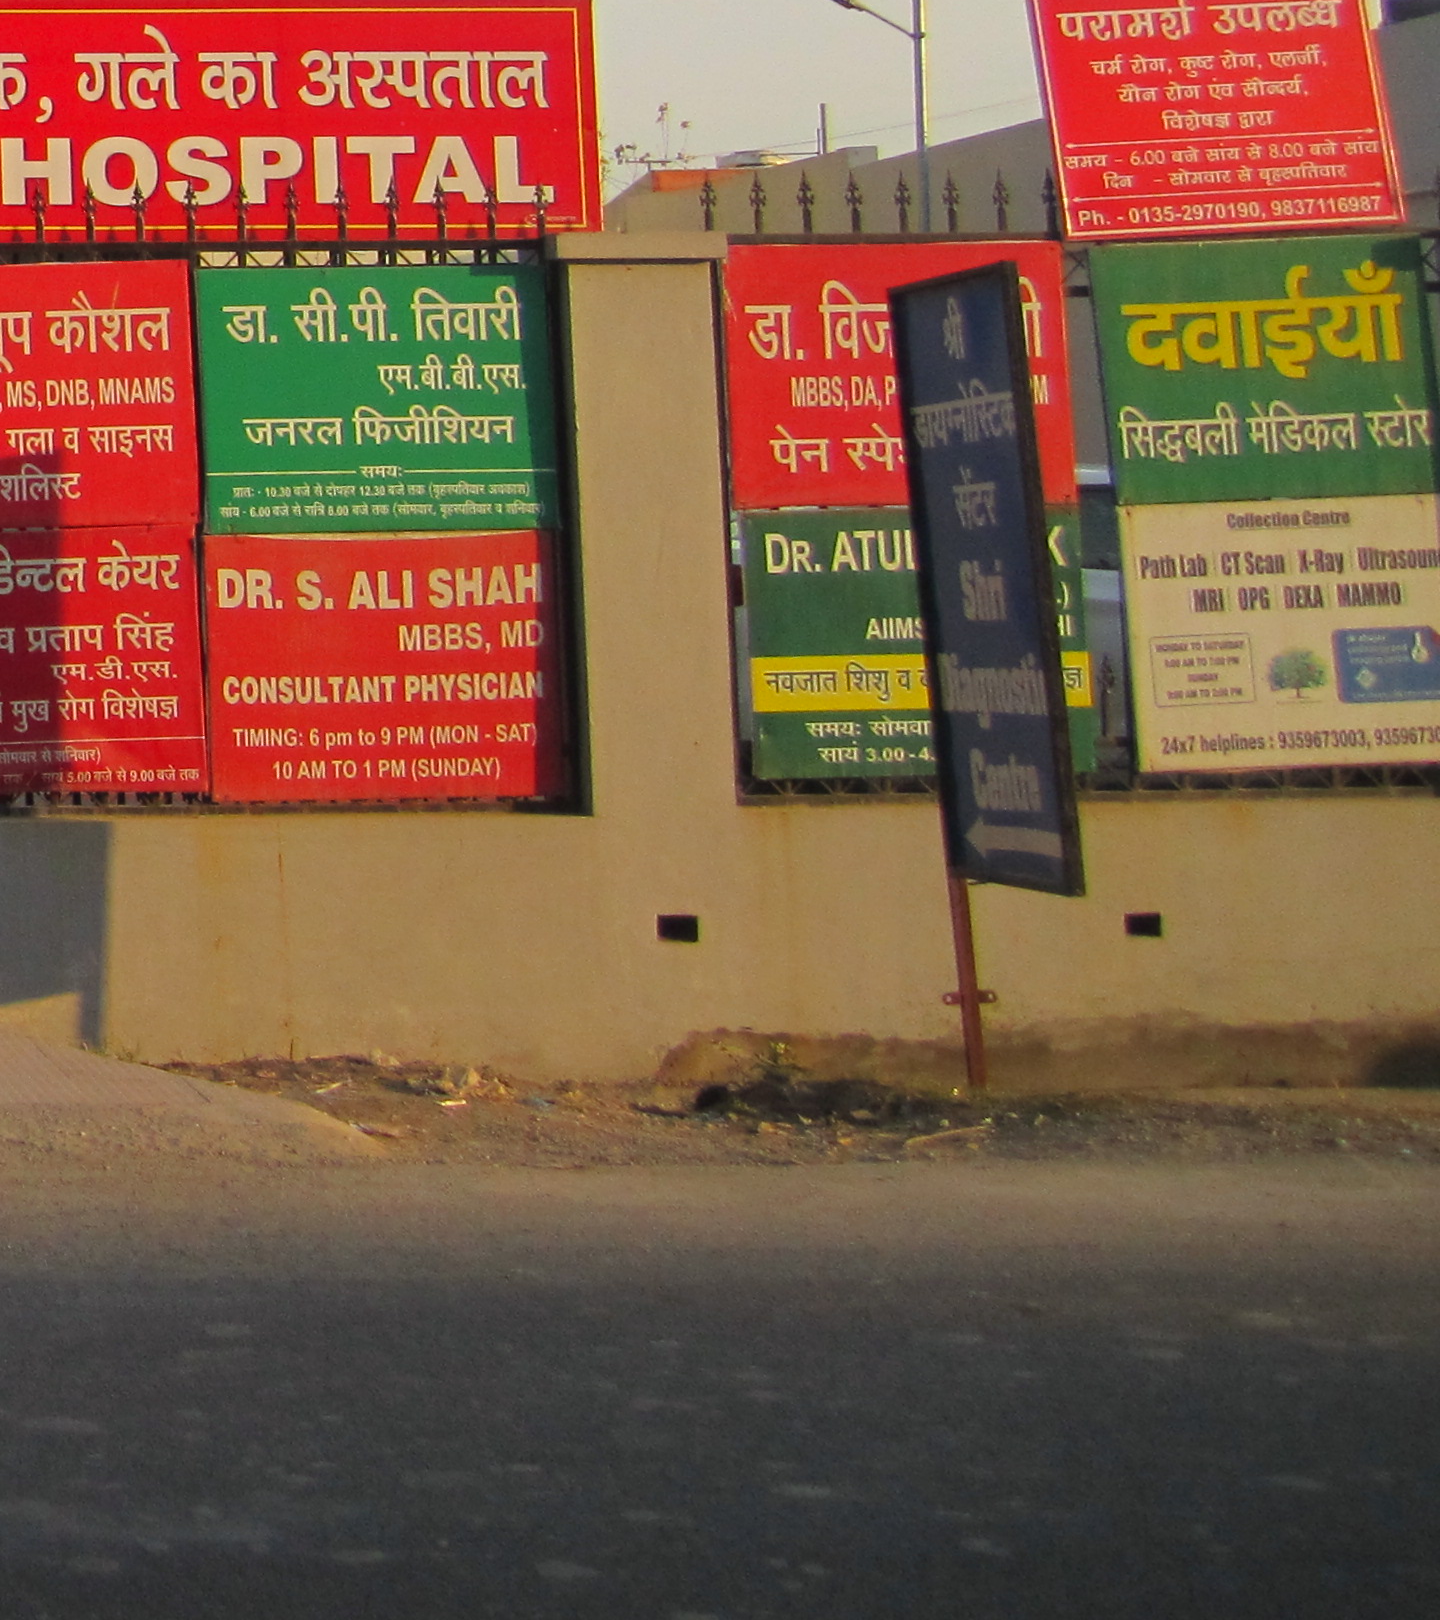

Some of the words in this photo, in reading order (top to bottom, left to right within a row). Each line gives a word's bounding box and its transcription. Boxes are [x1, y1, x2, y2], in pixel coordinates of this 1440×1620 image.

[1208, 0, 1342, 35] उपलब्ध
[75, 24, 181, 110] गले
[198, 50, 276, 110] का
[298, 50, 549, 110] अस्पताल
[1161, 110, 1229, 131] विशेषज्ञ
[1239, 110, 1274, 130] द्वारा
[0, 136, 554, 206] HOSPITAL
[1064, 153, 1107, 169] समय
[1130, 150, 1165, 166] 6.00
[1171, 147, 1199, 163] बजे
[1246, 141, 1263, 160] से
[1269, 143, 1304, 158] 8.00
[1308, 141, 1336, 157] बजे
[1103, 172, 1132, 189] दिन
[1169, 168, 1231, 186] सोमवार
[1237, 166, 1252, 184] से
[1078, 209, 1111, 226] Ph.
[1128, 202, 1266, 223] 0135-2970190,
[1272, 196, 1382, 216] 9837116987
[45, 290, 171, 354] कौशल
[223, 305, 278, 344] डा.
[291, 287, 398, 343] सी.पी.
[411, 285, 521, 341] तिवारी
[745, 304, 805, 360] डा.
[1121, 260, 1406, 379] दवाईयाँ
[378, 354, 527, 394] एम.बी.बी.एस.
[6, 379, 42, 412] MS,
[46, 379, 95, 411] DNB,
[99, 377, 175, 405] MNAMS
[791, 376, 848, 411] MBBS,
[851, 376, 882, 411] DA,
[5, 428, 54, 456] गला
[63, 427, 80, 454] व
[87, 425, 174, 459] साइनस
[243, 417, 343, 446] जनरल
[353, 404, 516, 445] फिजीशियन
[1119, 402, 1240, 463] सिद्धबली
[1245, 400, 1358, 454] मेडिकल
[1363, 394, 1433, 448] स्टोर
[770, 424, 830, 473] पेन
[1227, 511, 1299, 529] Collection
[1303, 510, 1351, 526] Centre
[97, 539, 181, 591] केयर
[1139, 555, 1175, 579] Path
[1180, 553, 1207, 577] Lab
[1221, 553, 1243, 576] CT
[1245, 552, 1285, 575] Scan
[1298, 549, 1345, 574] X-Ray
[217, 568, 283, 609] DR.
[296, 570, 334, 610] S.
[348, 570, 413, 610] ALI
[428, 563, 543, 607] SHAH
[1192, 588, 1223, 612] MRI
[1238, 587, 1270, 611] OPG
[1283, 585, 1324, 609] DEXA
[1336, 582, 1402, 607] MAMMO
[25, 625, 103, 654] प्रताप
[114, 611, 174, 653] सिंह
[398, 623, 491, 654] MBBS,
[501, 619, 545, 648] MD
[51, 656, 178, 684] एम.डी.एस.
[764, 669, 838, 694] नवजात
[846, 661, 892, 702] शिशु
[898, 669, 912, 691] व
[223, 675, 396, 705] CONSULTANT
[405, 671, 544, 702] PHYSICIAN
[11, 700, 50, 732] मुख
[59, 690, 95, 721] रोग
[102, 688, 178, 720] विशेषज्ञ
[233, 728, 303, 747] TIMING:
[309, 730, 319, 747] 6
[325, 732, 352, 751] pm
[359, 728, 375, 746] to
[381, 727, 391, 745] 9
[397, 727, 424, 745] PM
[430, 725, 479, 749] (MON
[495, 723, 538, 746] SAT)
[1161, 735, 1195, 756] 24x7
[1199, 733, 1265, 755] helplines
[273, 761, 293, 780] 10
[298, 760, 326, 779] AM
[332, 760, 357, 778] TO
[363, 760, 371, 778] 1
[379, 759, 405, 777] PM
[412, 757, 501, 781] (SUNDAY)
